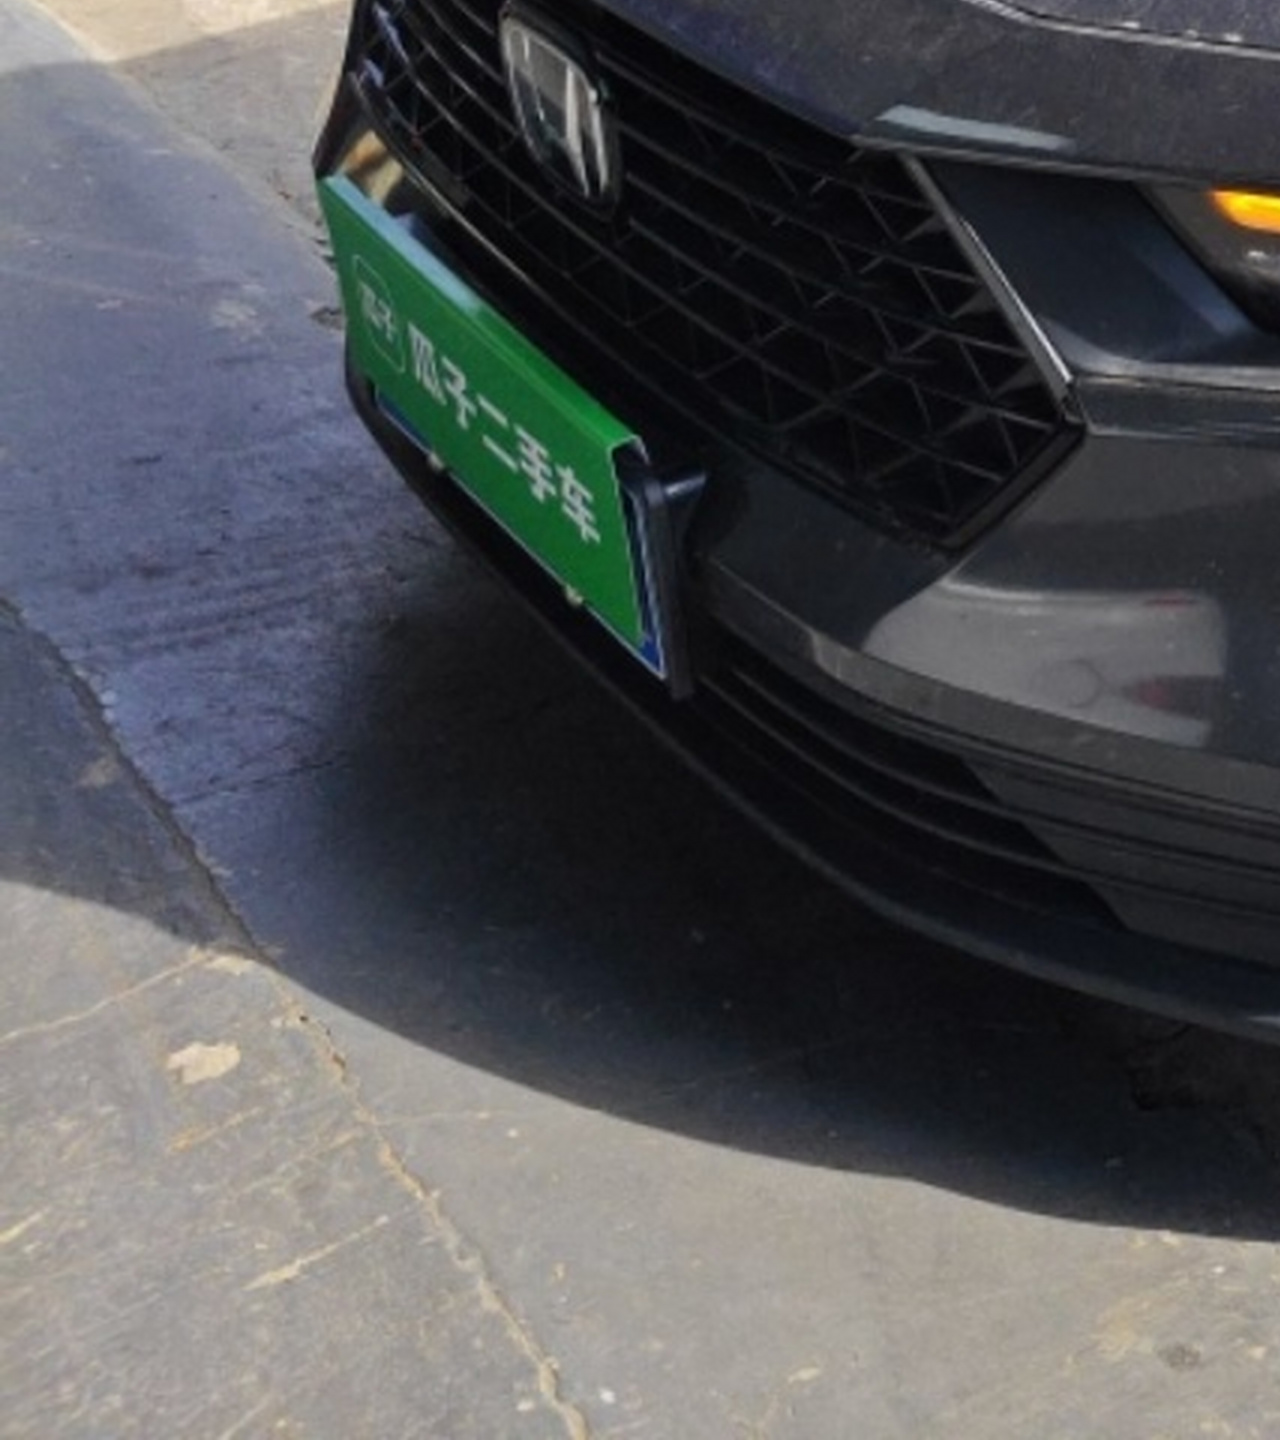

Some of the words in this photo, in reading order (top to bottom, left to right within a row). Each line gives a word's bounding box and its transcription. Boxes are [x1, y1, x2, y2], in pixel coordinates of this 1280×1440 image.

[408, 322, 601, 544] 瓜子二手车
